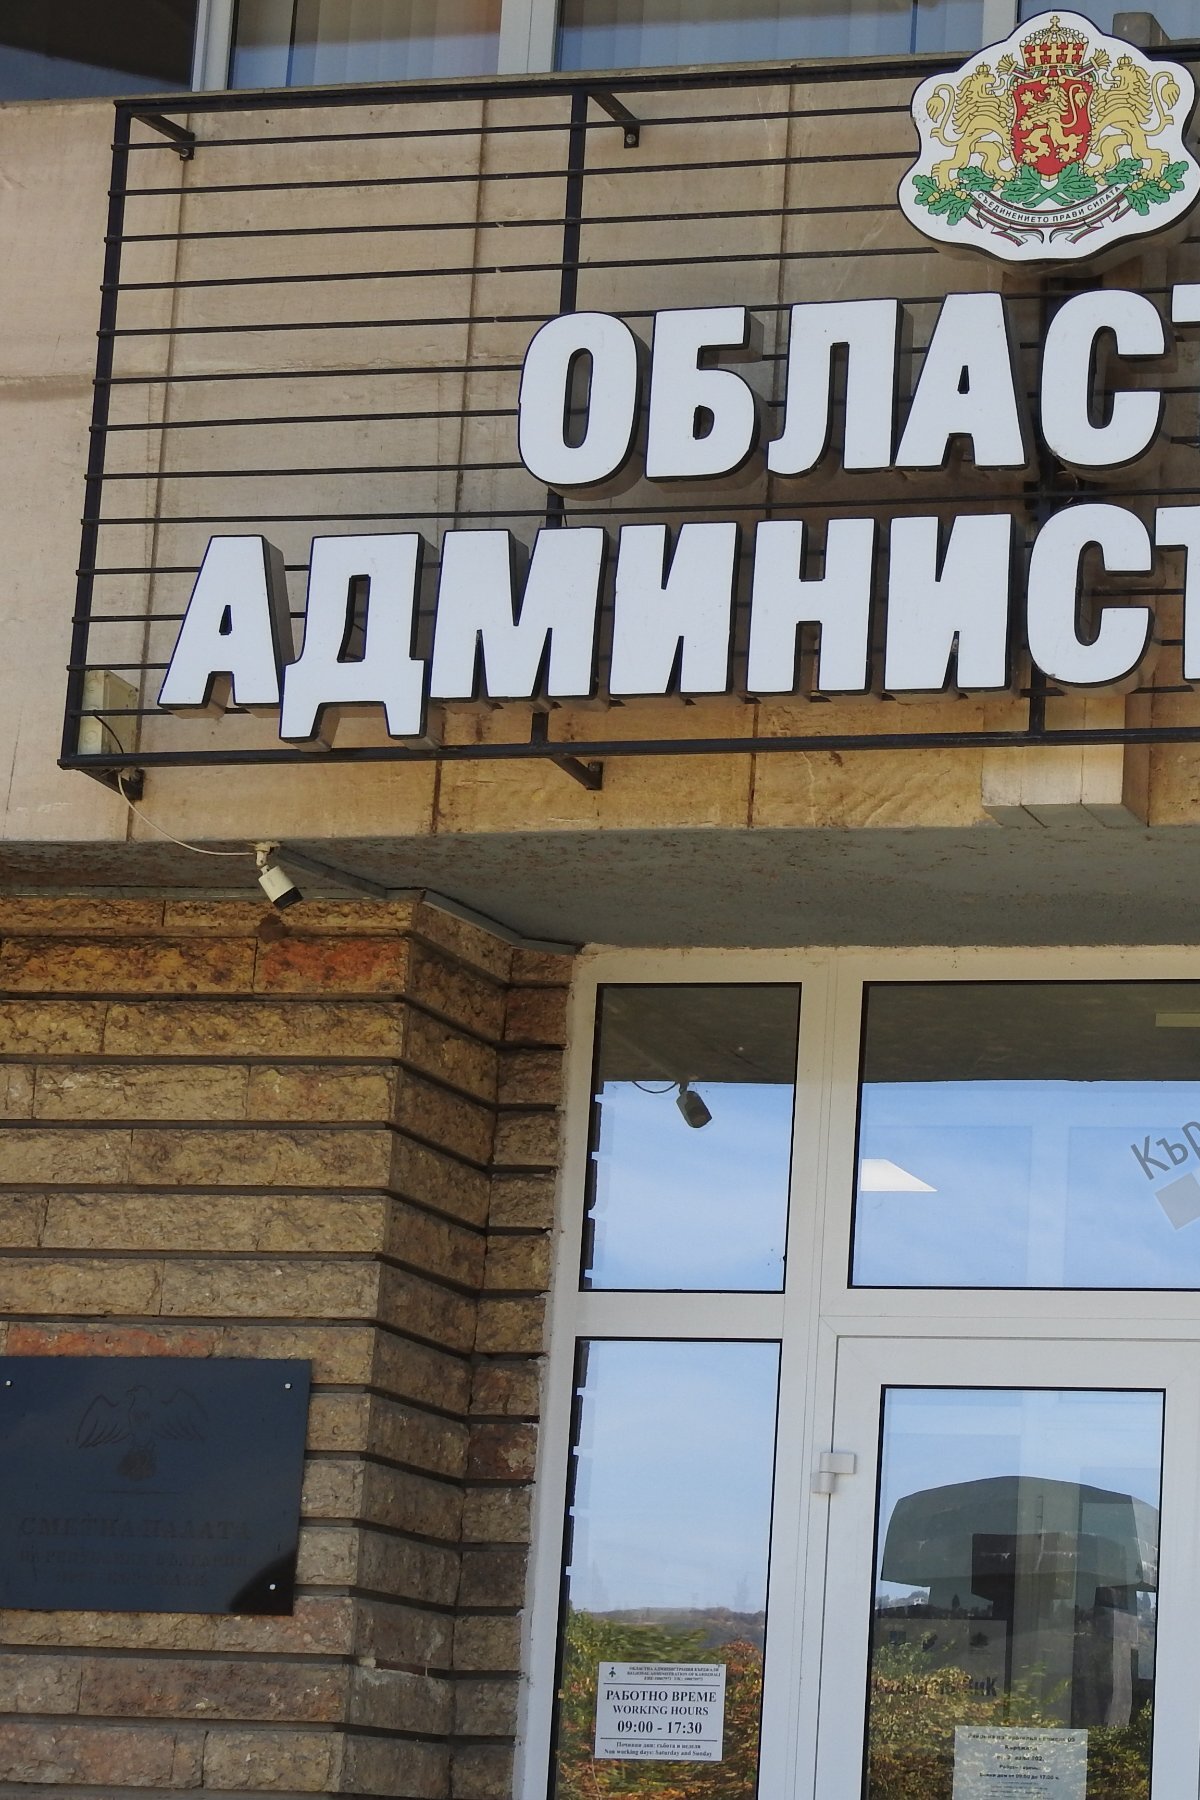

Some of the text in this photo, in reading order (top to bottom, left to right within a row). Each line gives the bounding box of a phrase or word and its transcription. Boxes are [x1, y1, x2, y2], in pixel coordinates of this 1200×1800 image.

[977, 185, 1122, 223] СЪЕДИНЕНИЕТО ПРАВИ СИЛАТА
[606, 1690, 717, 1703] РАБОТНО ВРЕМЕ
[613, 1704, 709, 1716] WORKING HOURS
[617, 1721, 653, 1733] 09:00
[668, 1722, 702, 1734] 17:30
